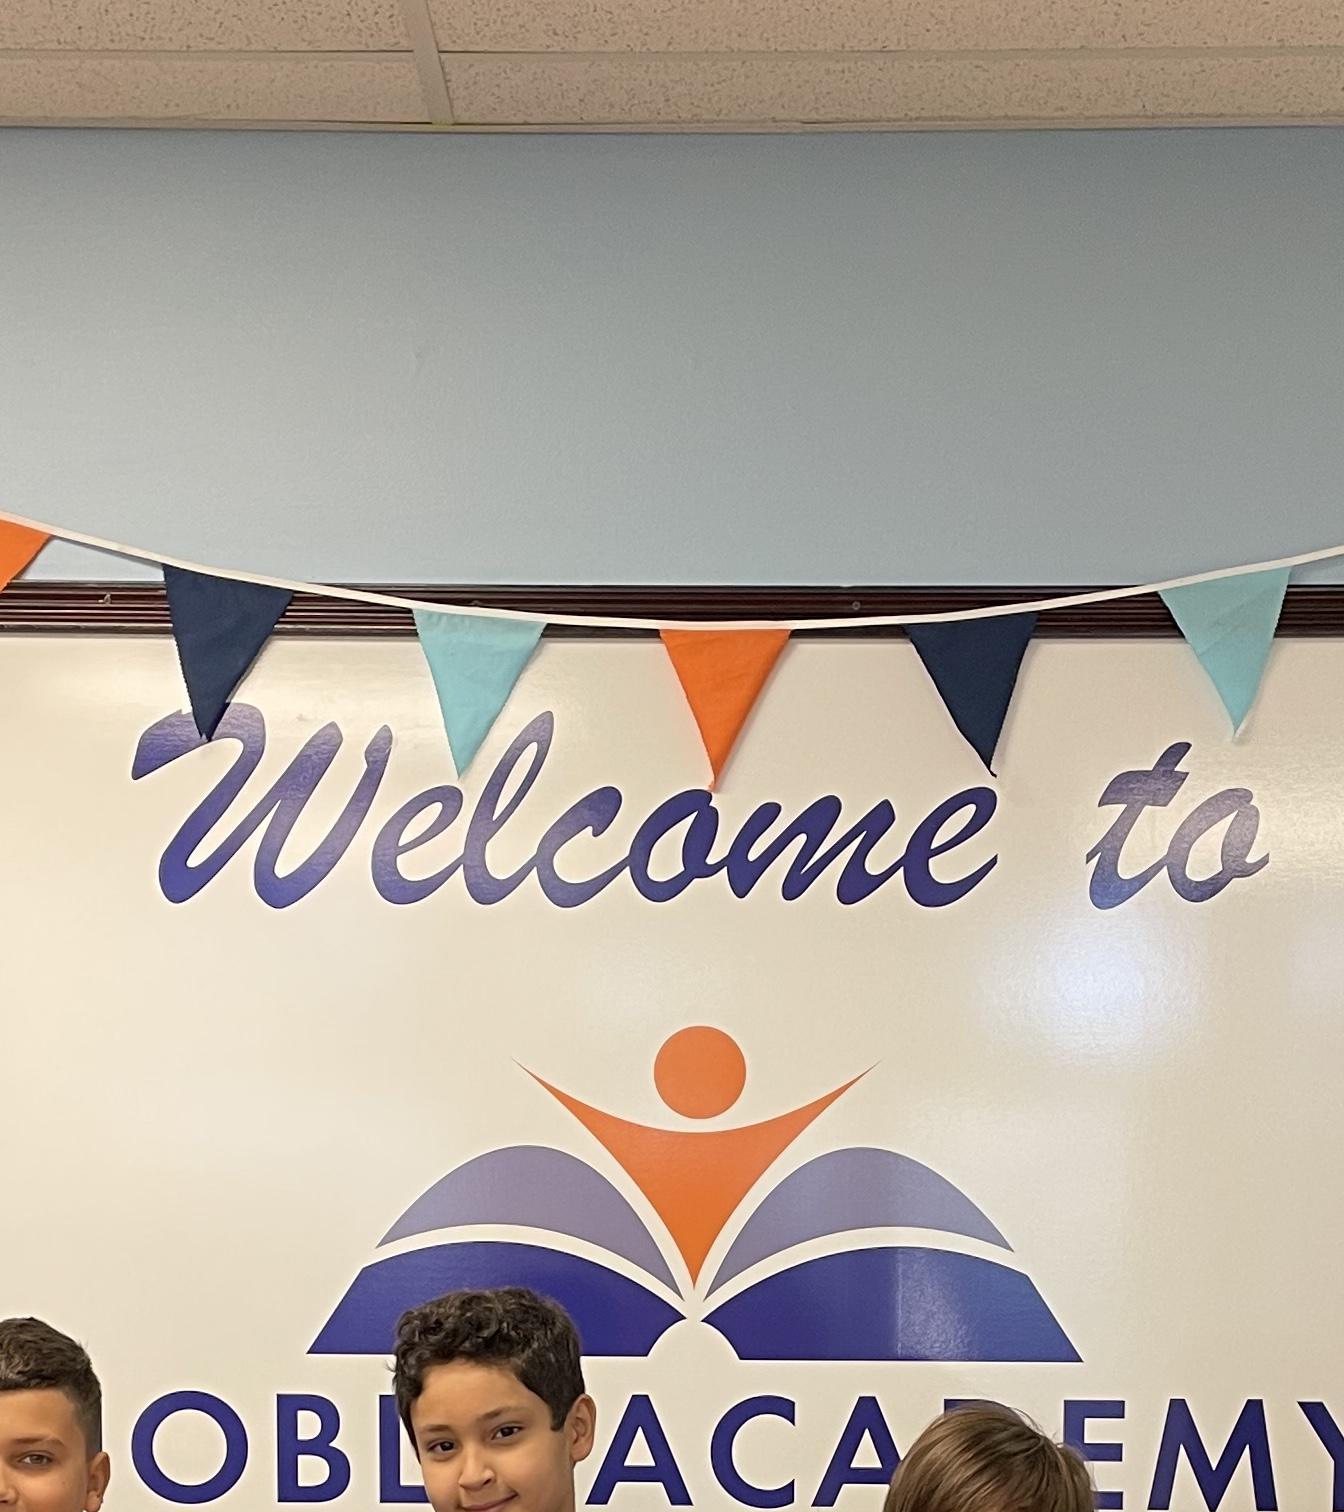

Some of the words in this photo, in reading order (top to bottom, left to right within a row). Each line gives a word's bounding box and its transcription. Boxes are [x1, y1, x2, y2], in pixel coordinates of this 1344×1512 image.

[131, 703, 999, 909] Welcome
[1086, 742, 1270, 909] to
[131, 1390, 429, 1504] OBL
